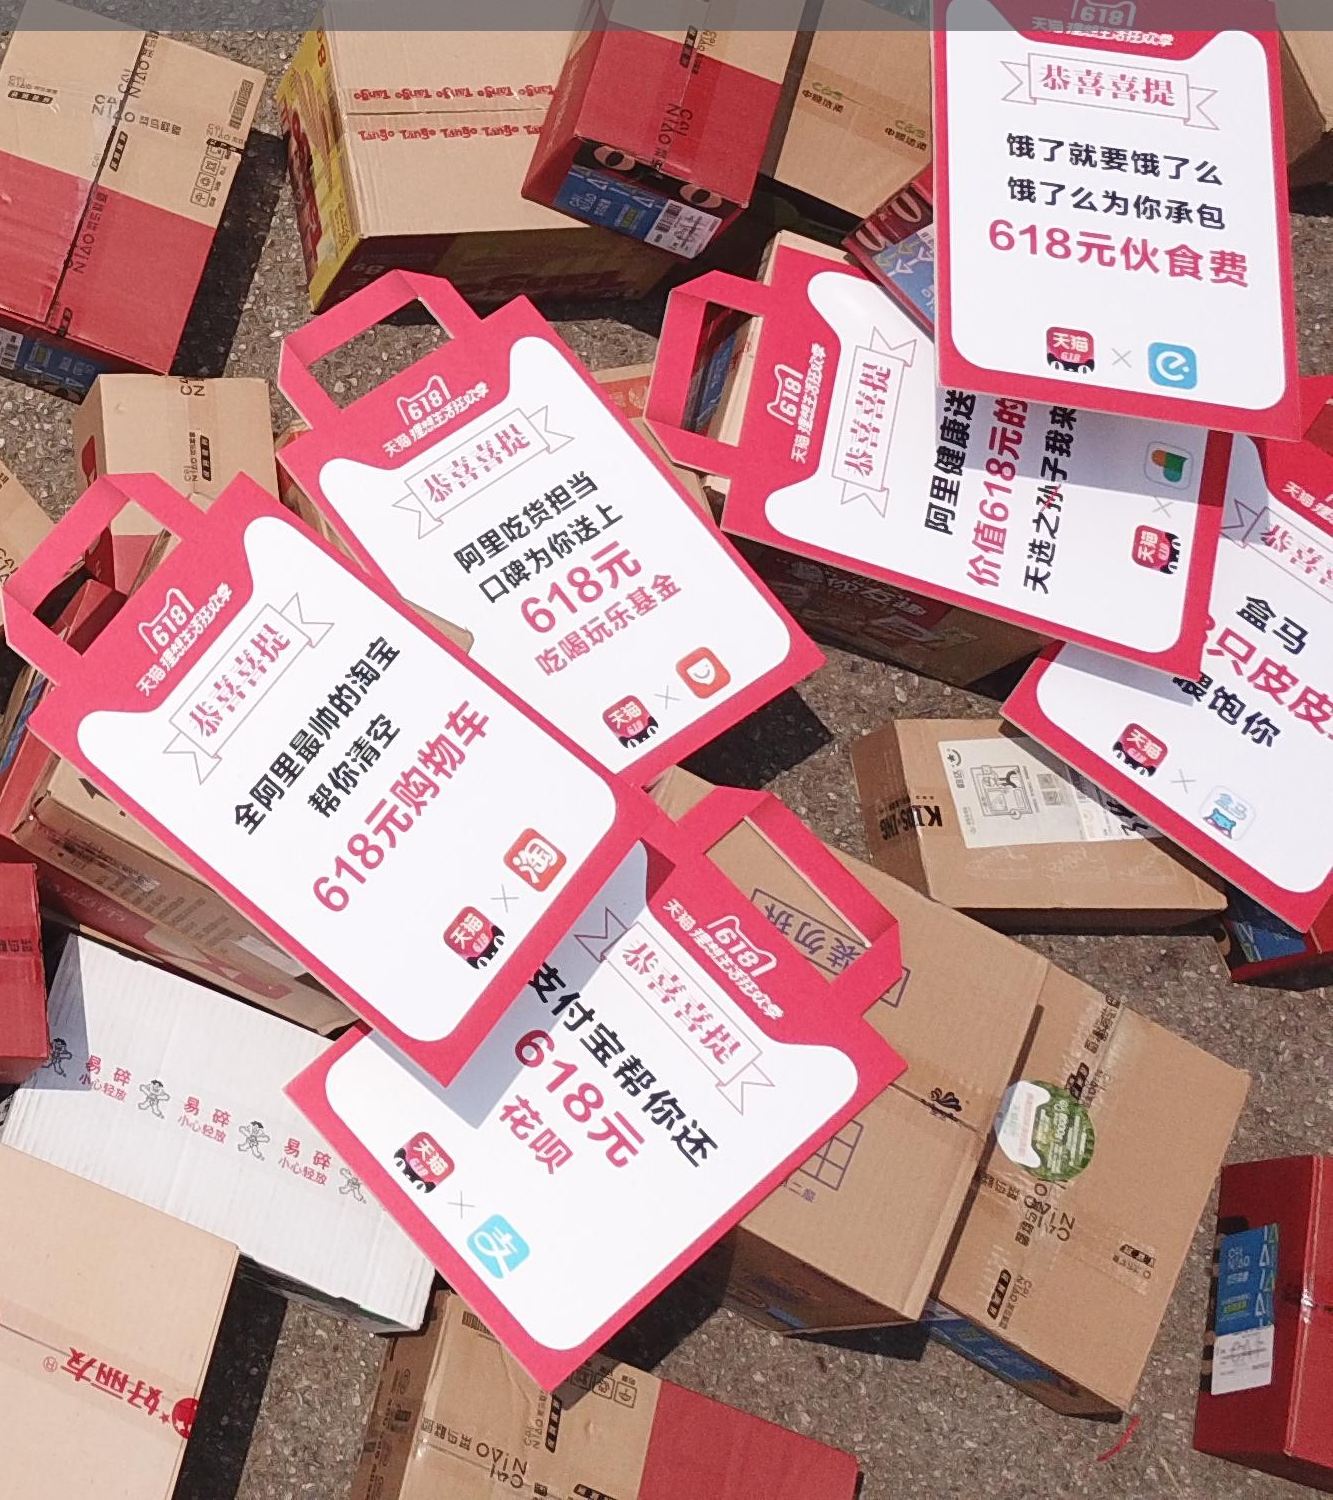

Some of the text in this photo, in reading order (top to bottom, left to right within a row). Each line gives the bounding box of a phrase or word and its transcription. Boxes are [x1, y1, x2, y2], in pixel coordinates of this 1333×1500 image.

[1006, 131, 1225, 186] 饿了就要饿了么
[1007, 176, 1226, 231] 饿了么为你承包
[989, 217, 1250, 289] 618元伙食费
[1052, 331, 1089, 353] 天猫
[408, 389, 444, 421] 618
[382, 434, 412, 459] 天猫
[925, 389, 976, 536] 阿里健康送
[967, 396, 1029, 588] 价值618元的
[453, 469, 599, 575] 阿里吃货担当
[479, 501, 624, 604] 口碑为你送上
[520, 540, 643, 635] 618元
[152, 606, 190, 647] 618
[534, 572, 683, 677] 吃喝玩乐基金
[1237, 595, 1310, 656] 盒马
[135, 665, 168, 698] 天猫
[1205, 617, 1333, 740] 只皮皮
[234, 636, 401, 836] 全阿里最帅的淘宝
[607, 701, 642, 728] 天猫
[309, 713, 402, 818] 帮你清空
[312, 701, 493, 913] 618元购物车
[511, 837, 559, 880] 淘
[448, 914, 485, 949] 天猫
[662, 897, 698, 933] 天猫
[718, 924, 759, 972] 618
[78, 1072, 127, 1103] 小心轻放
[528, 962, 719, 1168] 支付宝帮你还
[514, 1028, 646, 1170] 618元
[177, 1113, 227, 1145] 小心轻放
[498, 1093, 575, 1176] 花呗
[277, 1155, 329, 1187] 小心轻放
[414, 1140, 448, 1177] 天猫
[60, 1346, 163, 1417] 好丽友
